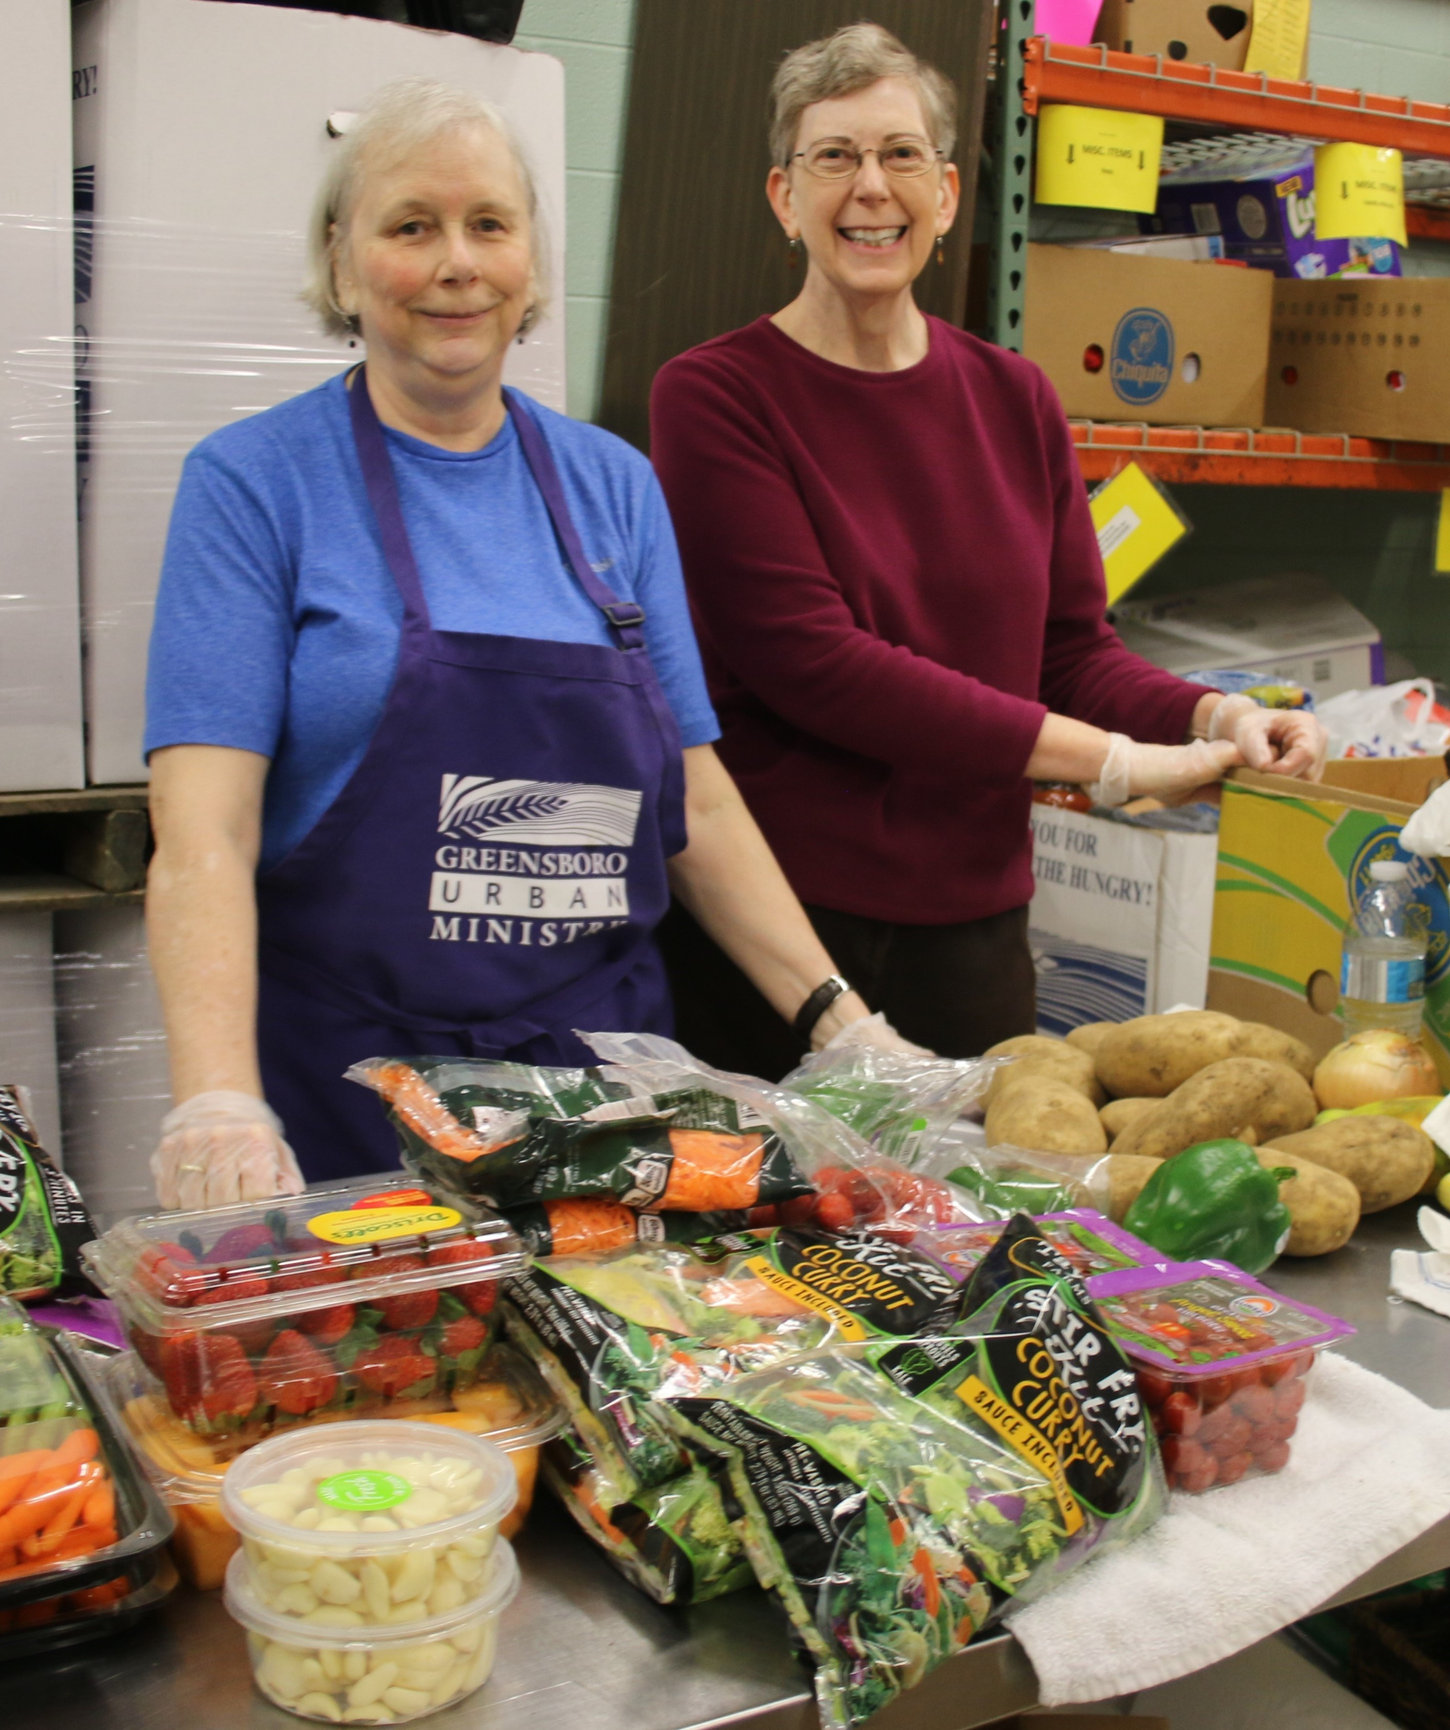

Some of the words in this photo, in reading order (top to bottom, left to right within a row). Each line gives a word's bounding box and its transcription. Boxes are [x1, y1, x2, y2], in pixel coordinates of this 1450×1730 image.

[435, 846, 628, 875] GREENSBORO
[1065, 828, 1097, 857] FOR
[441, 880, 623, 909] URBAN
[1036, 856, 1067, 885] THE
[1070, 864, 1153, 906] HUNGRY!
[757, 1265, 794, 1293] SAUCE
[791, 1262, 872, 1306] CURRY
[801, 1244, 915, 1311] COCONUT
[1023, 1288, 1102, 1367] STIR
[973, 1390, 1025, 1437] SAUCE
[1011, 1380, 1086, 1469] CURRY
[1016, 1336, 1115, 1478] COCONUT
